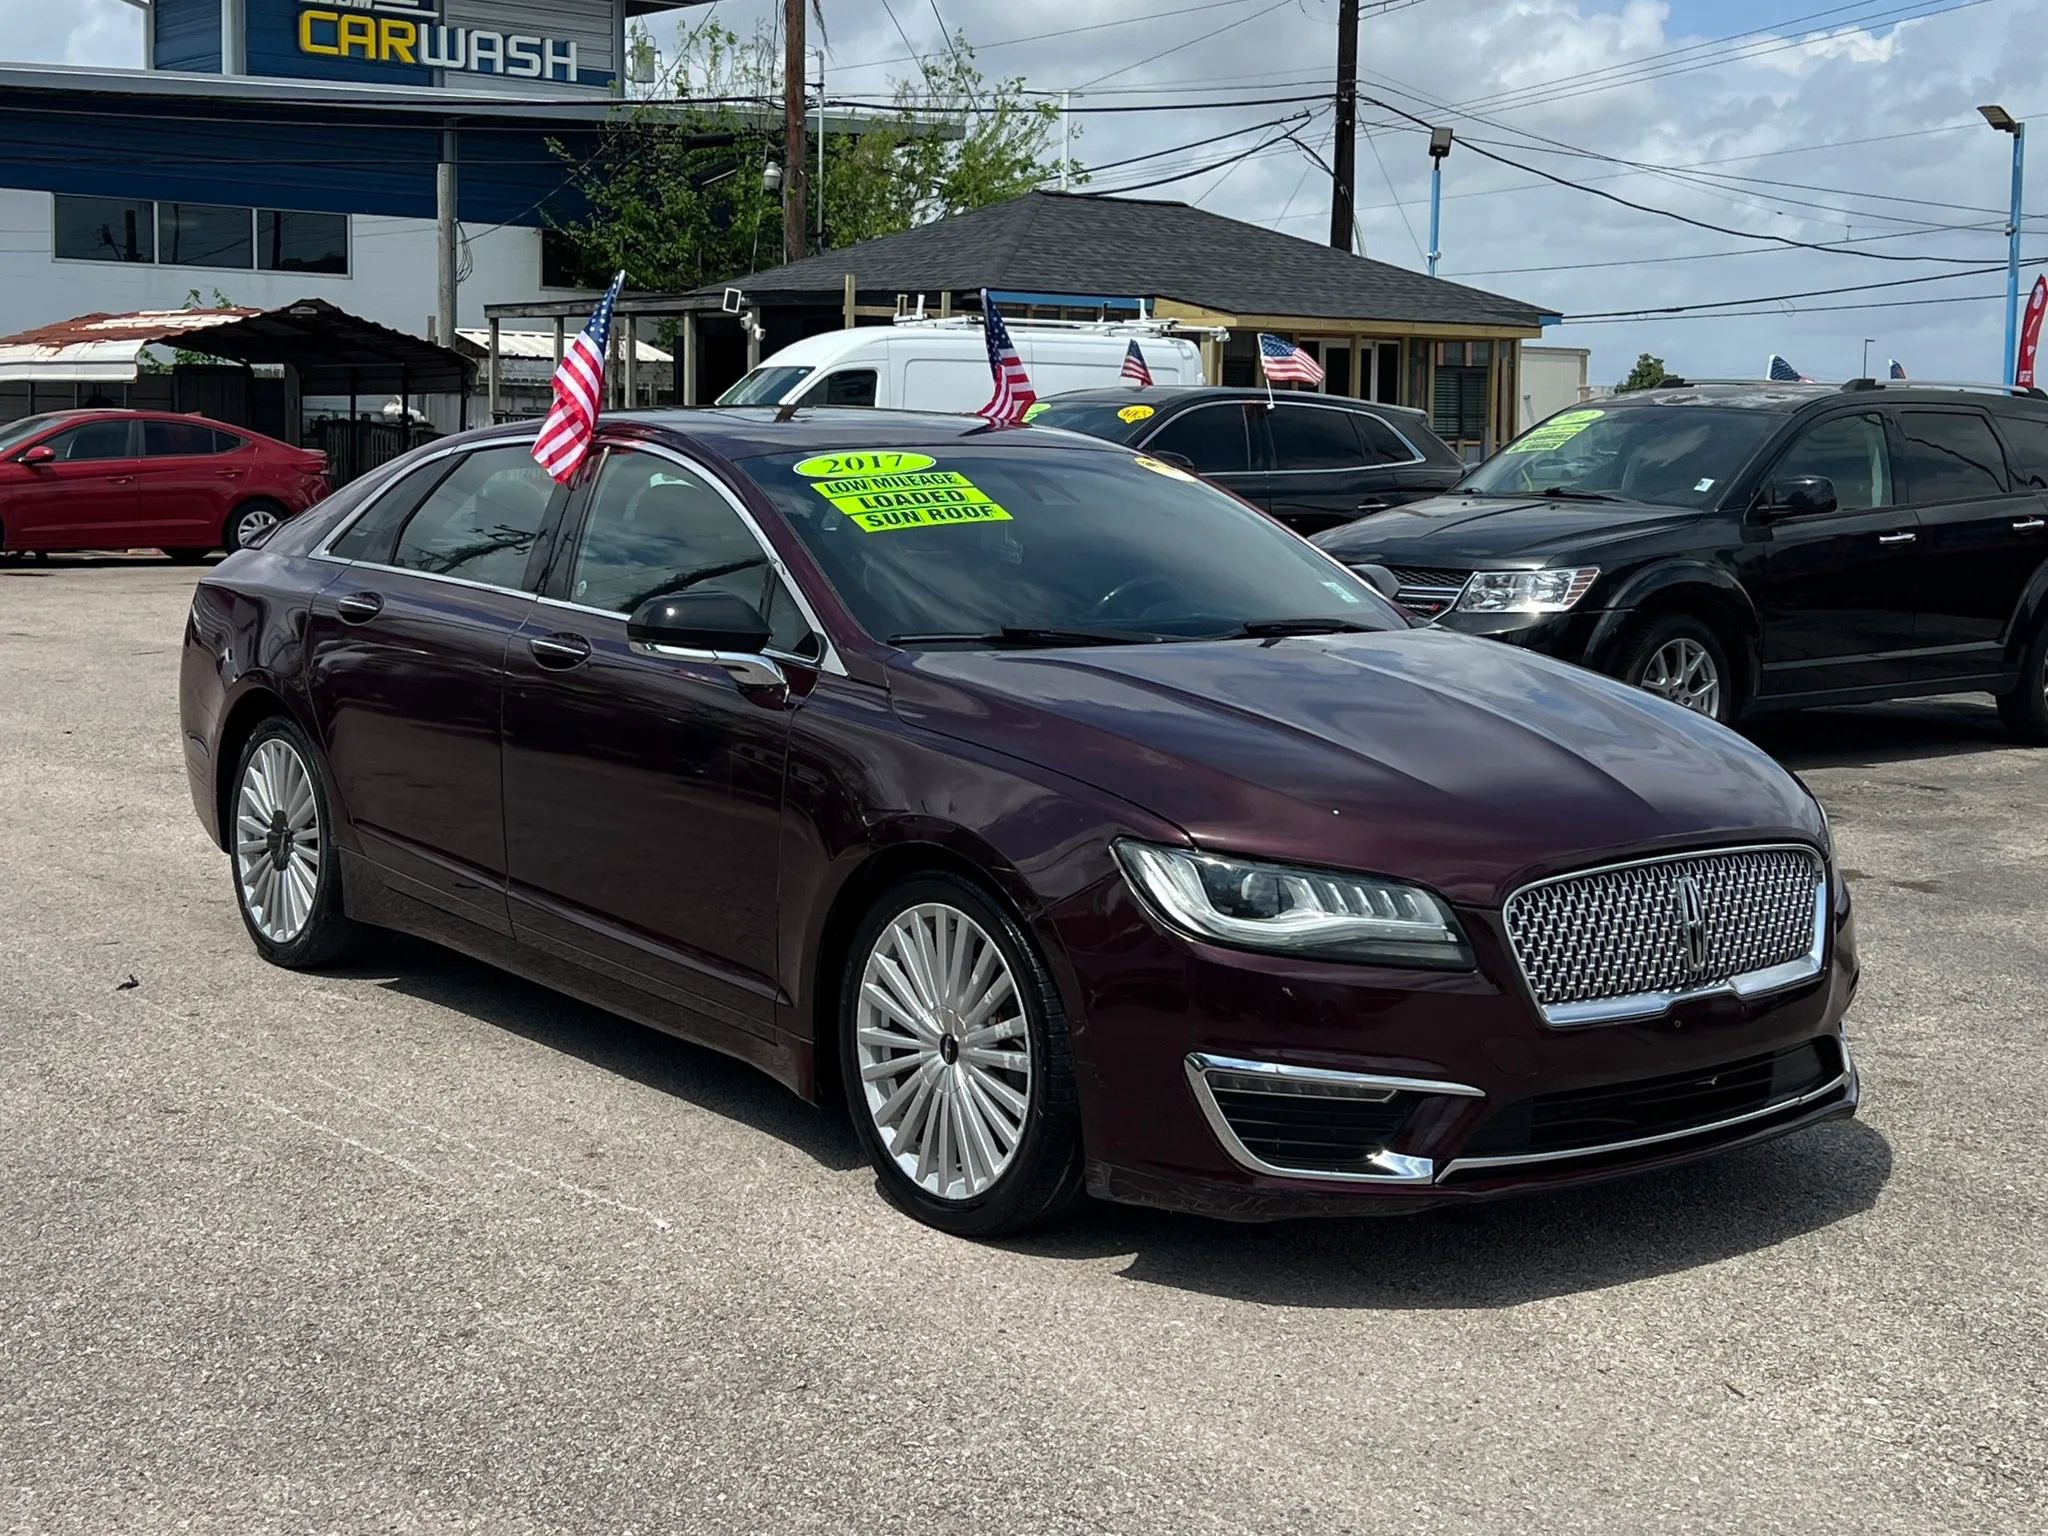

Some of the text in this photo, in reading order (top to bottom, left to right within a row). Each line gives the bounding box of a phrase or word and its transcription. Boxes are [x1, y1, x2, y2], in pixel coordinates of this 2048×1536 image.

[822, 454, 904, 474] 2017
[824, 473, 955, 495] LOW MILEAGE
[858, 490, 967, 510] LOADED
[865, 505, 993, 528] SUN ROOF
